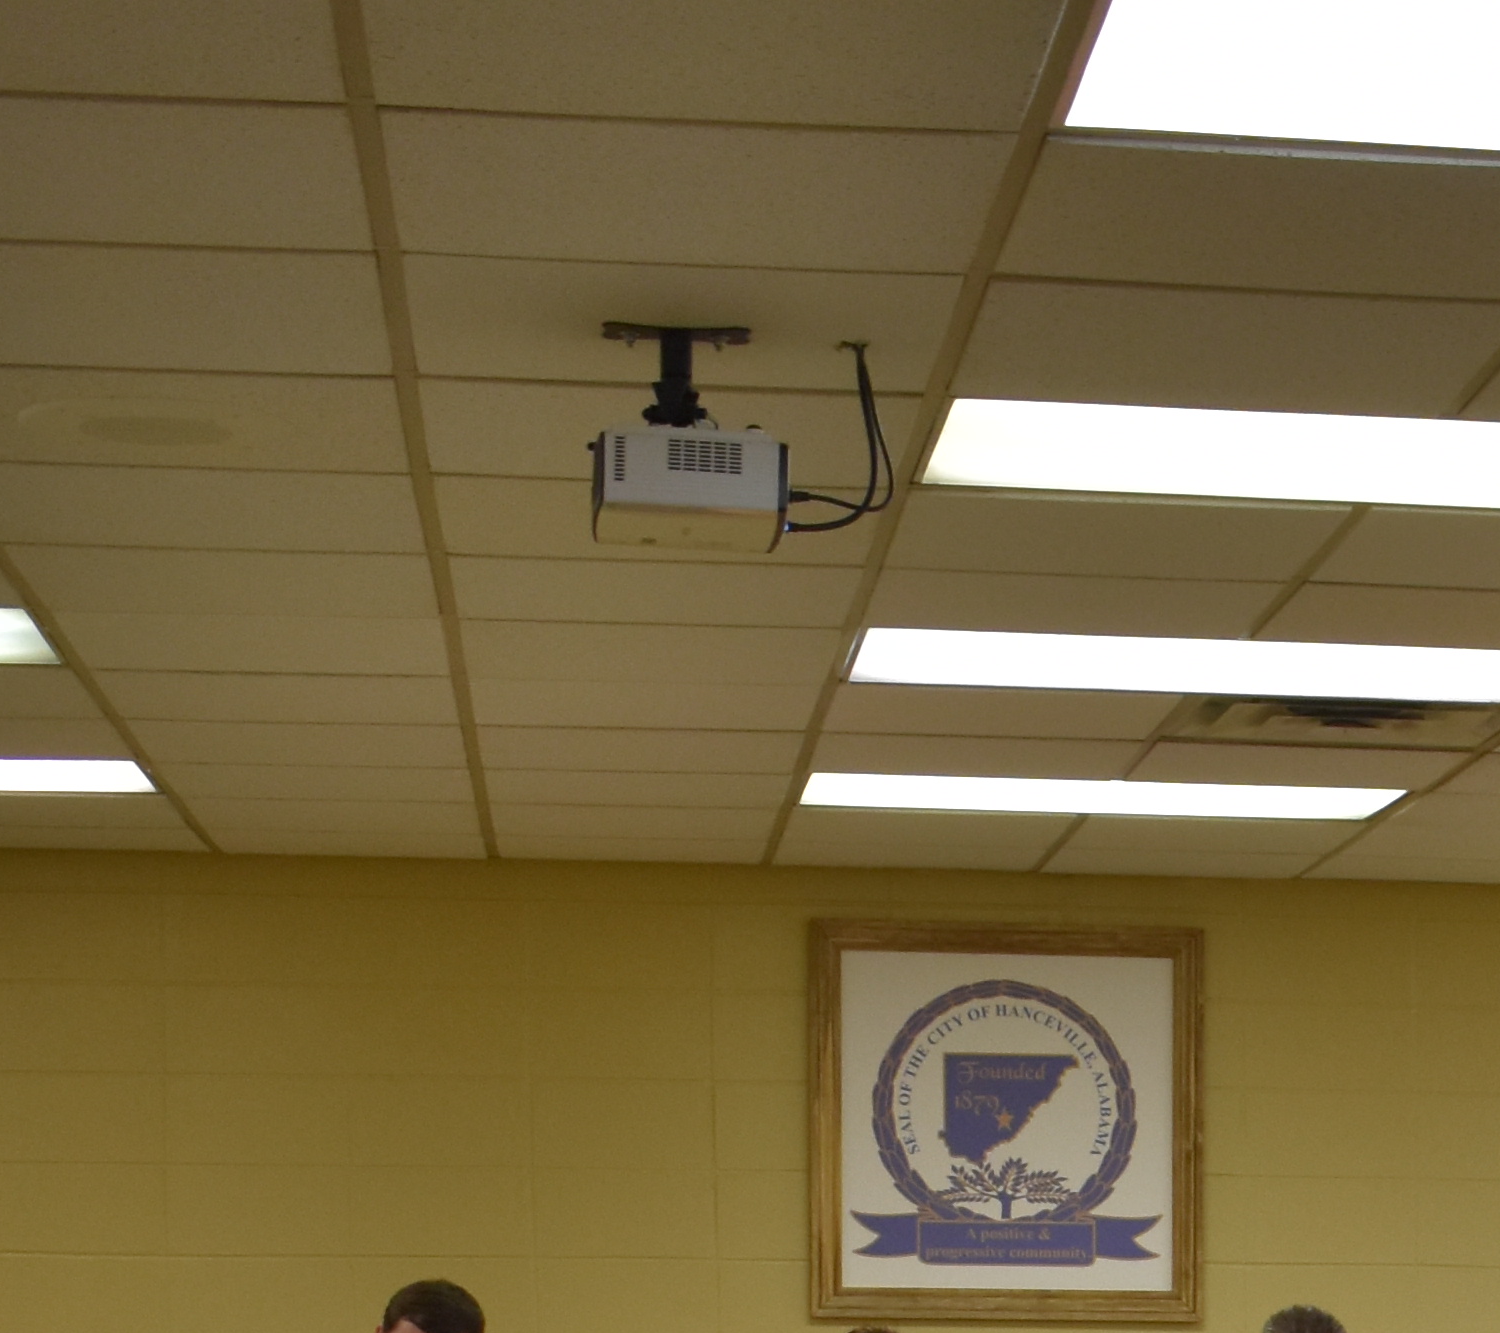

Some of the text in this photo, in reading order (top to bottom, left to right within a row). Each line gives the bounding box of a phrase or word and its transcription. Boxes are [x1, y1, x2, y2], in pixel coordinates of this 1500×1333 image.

[967, 1005, 991, 1021] OF
[927, 1014, 963, 1045] CITY
[903, 1044, 929, 1077] THE
[958, 1061, 1047, 1083] Founded
[899, 1081, 912, 1106] OF
[1090, 1071, 1112, 1155] ALABAMA
[899, 1110, 920, 1155] SEAL
[981, 1226, 1034, 1243] positive
[1038, 1227, 1051, 1240] &
[925, 1246, 1005, 1260] progressive
